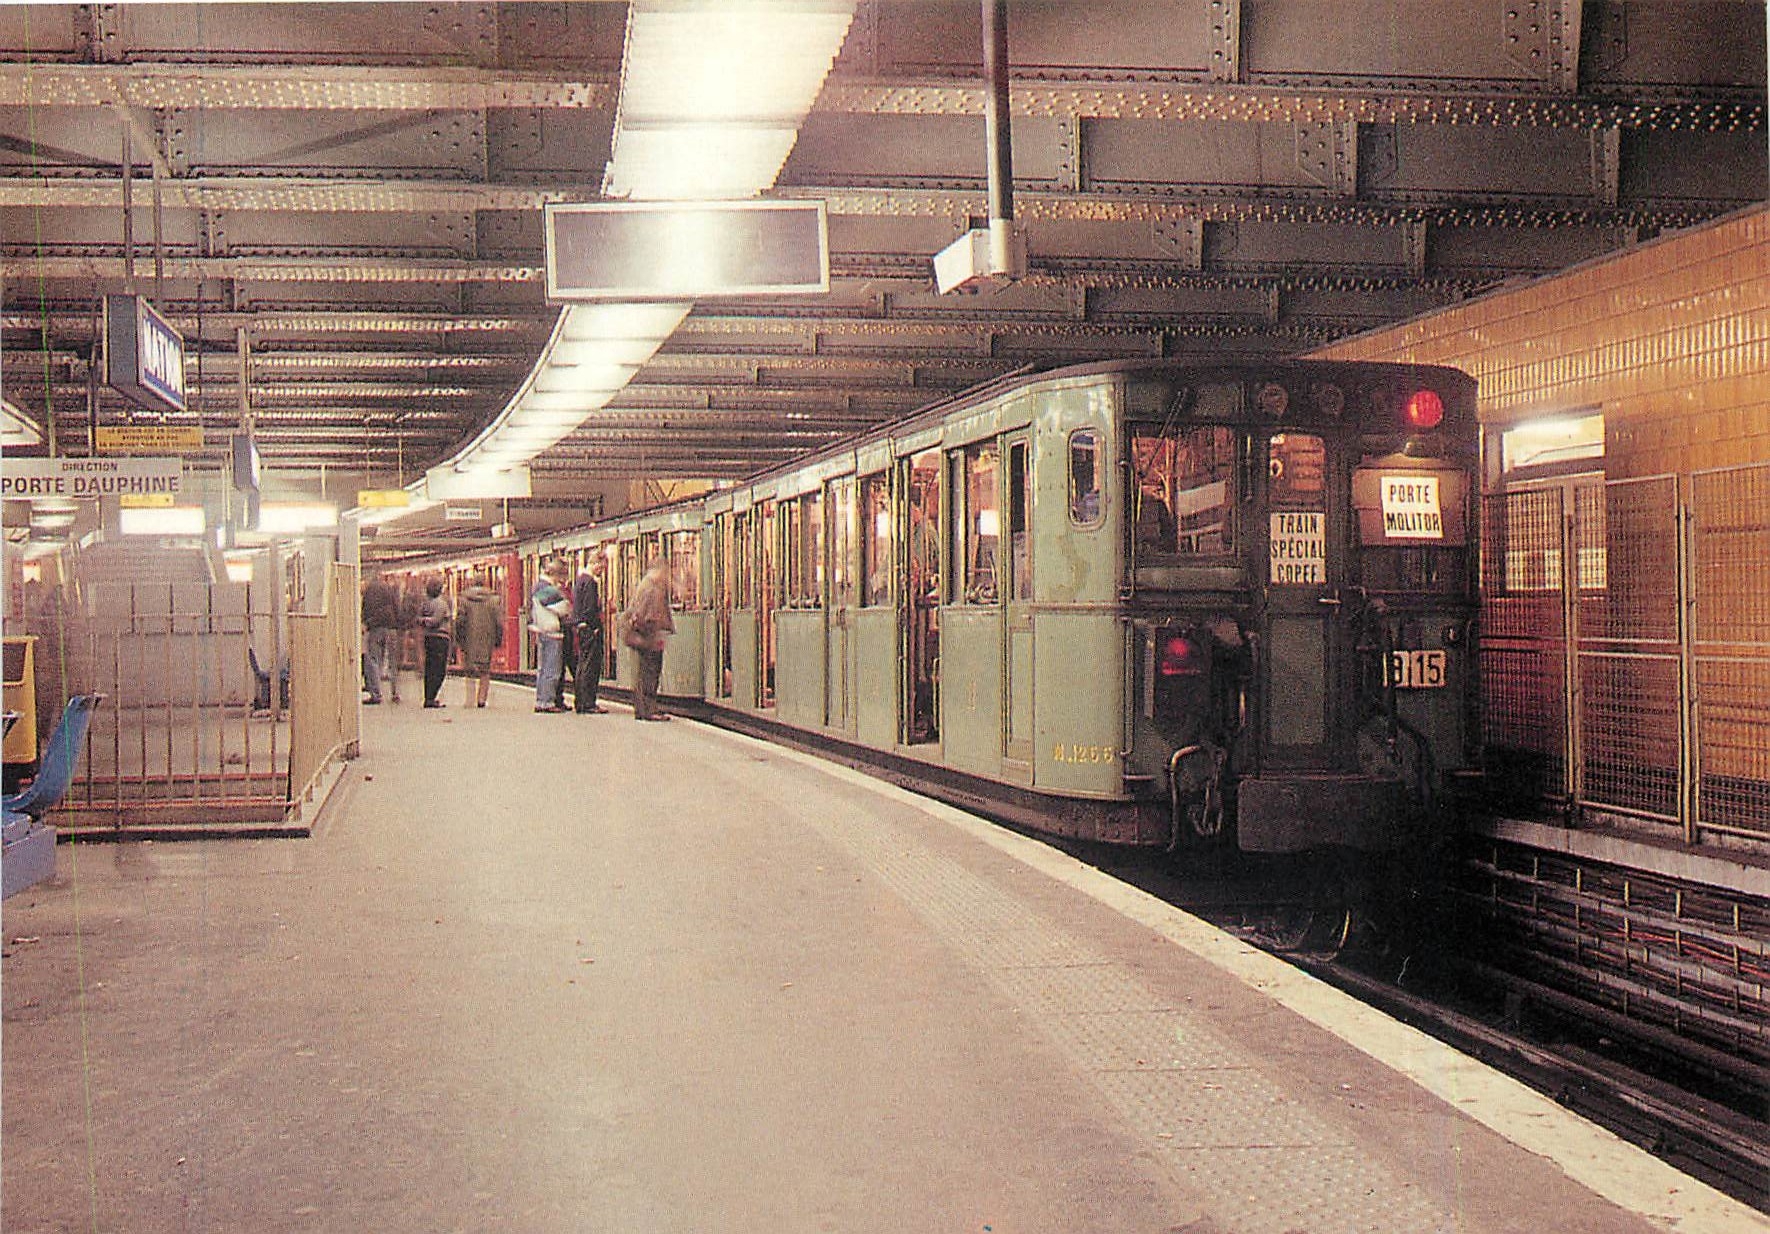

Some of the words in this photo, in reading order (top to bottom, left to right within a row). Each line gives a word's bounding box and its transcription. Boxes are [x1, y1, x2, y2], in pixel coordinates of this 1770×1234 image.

[62, 462, 119, 472] DIRECTION
[1, 477, 65, 493] PORTE
[73, 476, 179, 493] DAUPHINE
[1390, 484, 1431, 503] PORTE
[1279, 514, 1318, 534] TRAIN
[1386, 512, 1440, 531] MOLITOR
